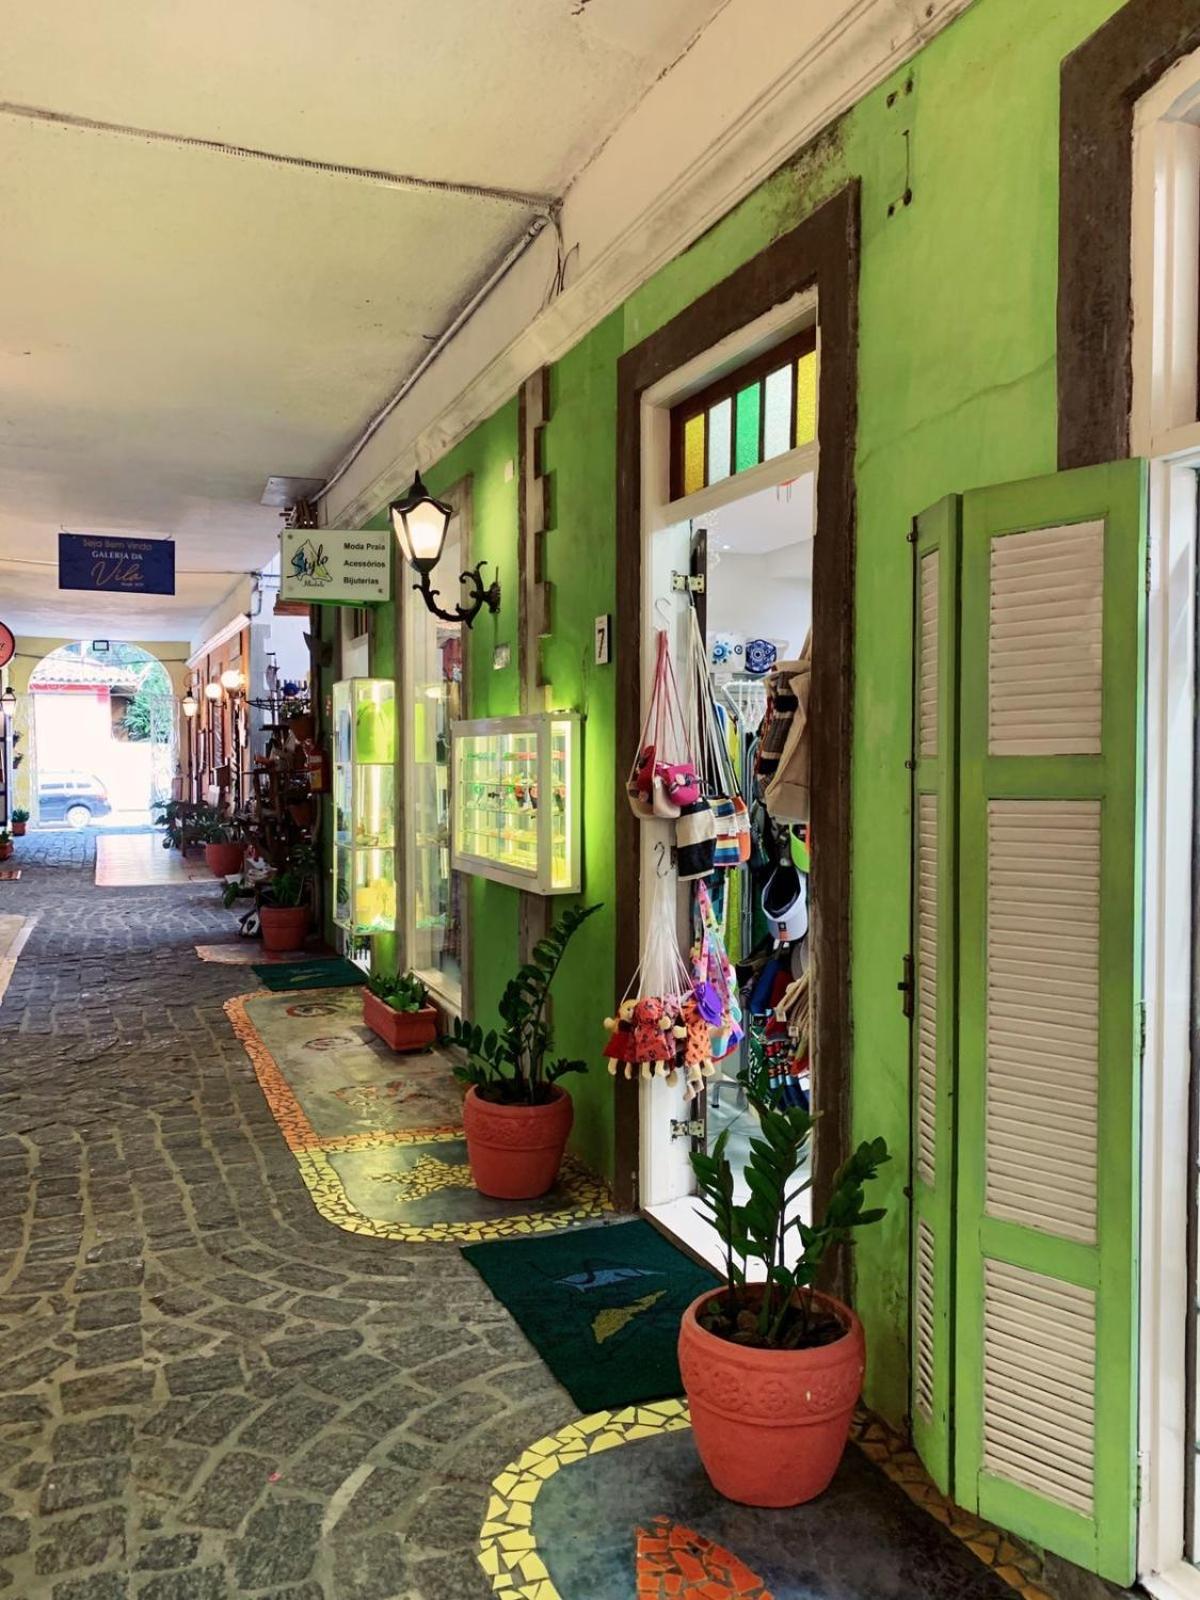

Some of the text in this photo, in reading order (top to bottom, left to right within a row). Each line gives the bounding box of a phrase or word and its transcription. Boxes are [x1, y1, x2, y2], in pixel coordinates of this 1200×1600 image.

[343, 542, 385, 550] Moda Praia
[91, 550, 129, 560] GALERIA
[343, 559, 386, 568] Acessórios
[90, 557, 144, 586] Vila
[343, 576, 379, 585] Bijuterias
[597, 627, 605, 658] 7
